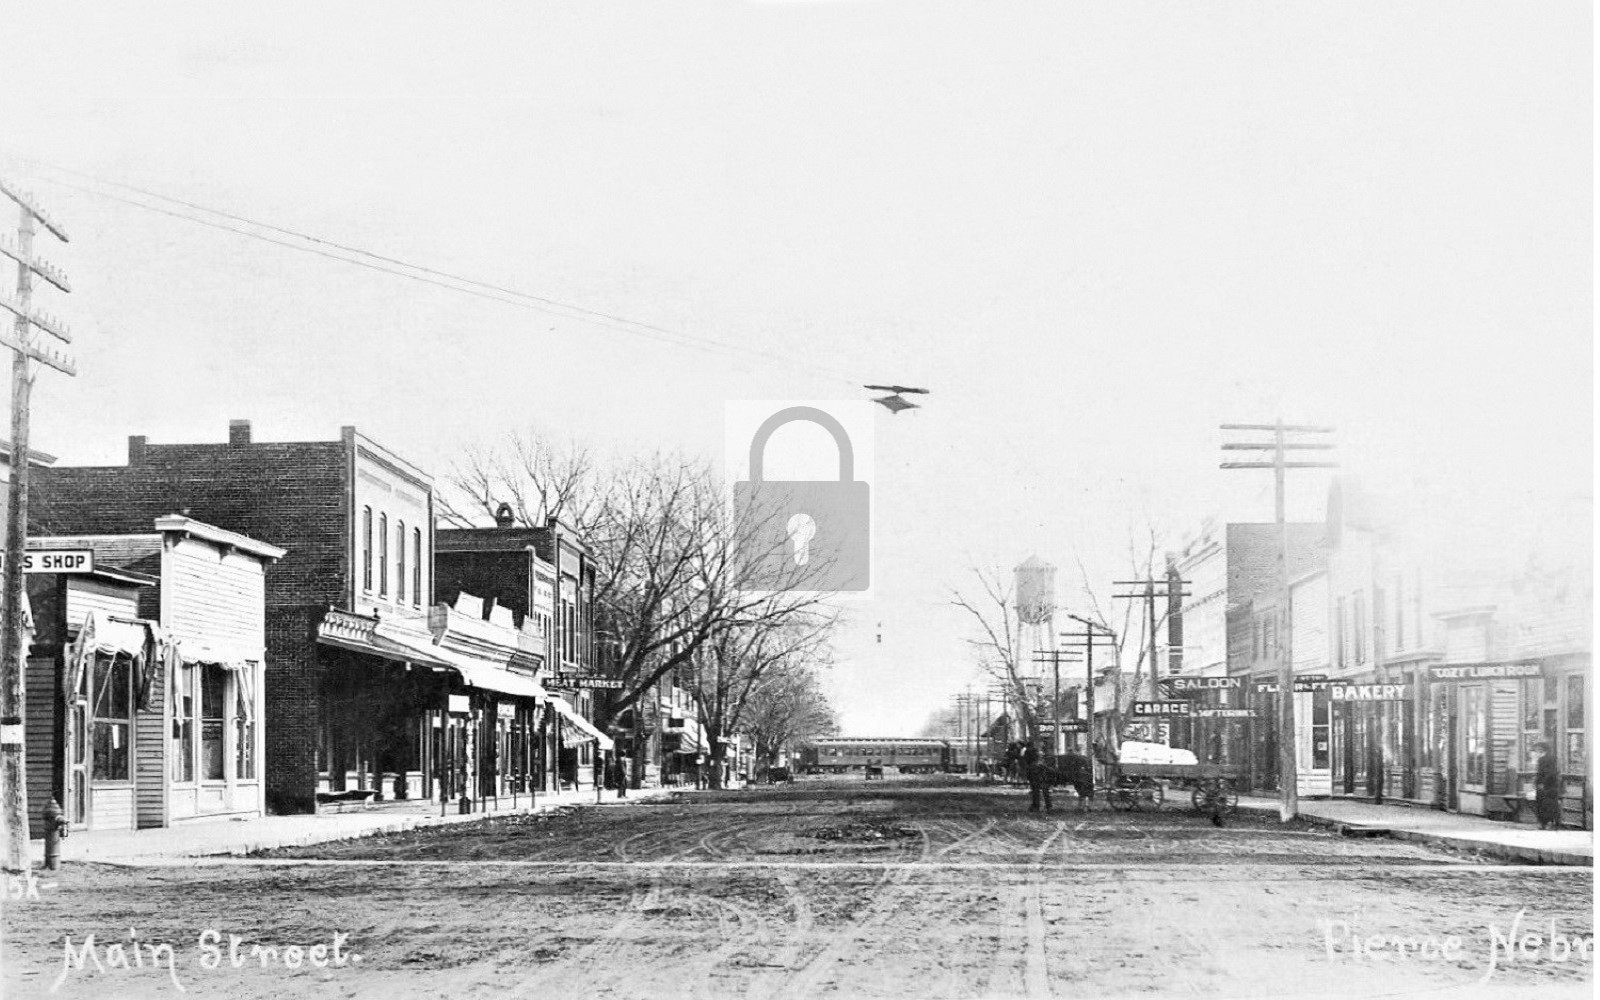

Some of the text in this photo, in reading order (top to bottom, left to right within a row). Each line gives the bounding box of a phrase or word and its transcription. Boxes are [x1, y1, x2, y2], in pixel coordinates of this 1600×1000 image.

[42, 555, 85, 568] SHOP
[1506, 664, 1540, 676] ROOM
[546, 678, 624, 689] MEAT MARKET
[1174, 677, 1241, 689] SALOON
[1331, 685, 1406, 700] BAKERY
